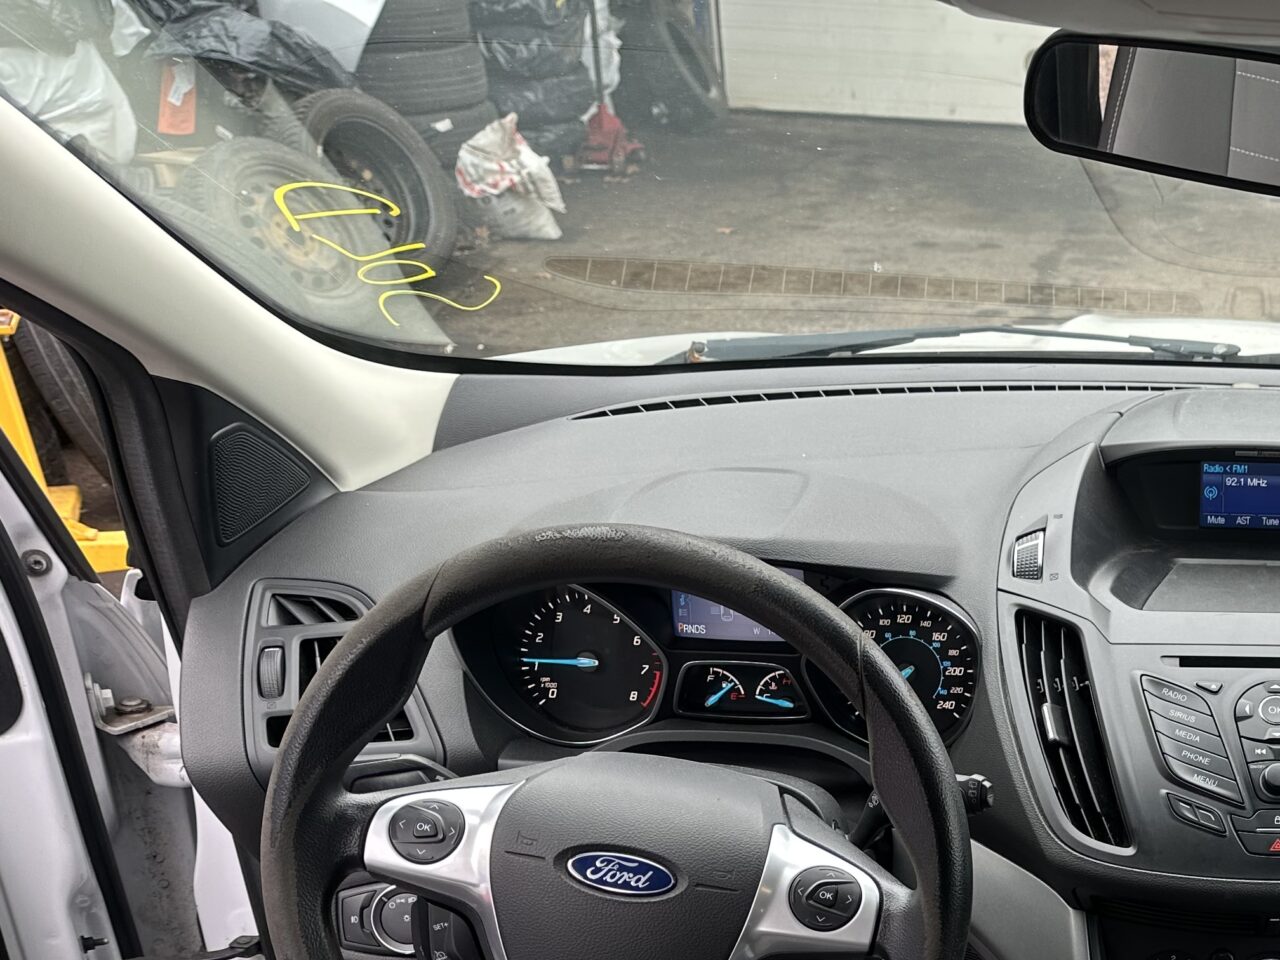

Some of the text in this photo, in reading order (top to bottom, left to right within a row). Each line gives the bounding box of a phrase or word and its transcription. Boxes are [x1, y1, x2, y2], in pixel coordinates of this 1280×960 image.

[1203, 464, 1248, 474] Radio FM1
[1225, 477, 1268, 487] 92.1 MHz
[1207, 516, 1225, 525] Mute
[1236, 516, 1251, 525] AST
[1262, 517, 1280, 526] Tune
[583, 604, 592, 614] 4
[555, 613, 563, 623] 3
[613, 614, 621, 624] 5
[896, 615, 912, 624] 120
[678, 622, 706, 634] PRNDS
[535, 633, 544, 643] 2
[633, 635, 641, 645] 6
[932, 632, 948, 641] 160
[640, 665, 649, 675] 7
[945, 667, 964, 676] 200
[549, 688, 557, 698] 0
[629, 691, 638, 701] 8
[1162, 687, 1187, 702] RADIO
[936, 701, 956, 710] 240
[1168, 709, 1196, 724] SIRIUS
[1175, 728, 1200, 743] MEDIA
[1181, 750, 1211, 766] PHONE
[1192, 773, 1219, 787] MENU
[416, 822, 432, 832] OK
[586, 856, 654, 889] Ford
[819, 891, 834, 900] OK
[432, 922, 449, 931] SET+
